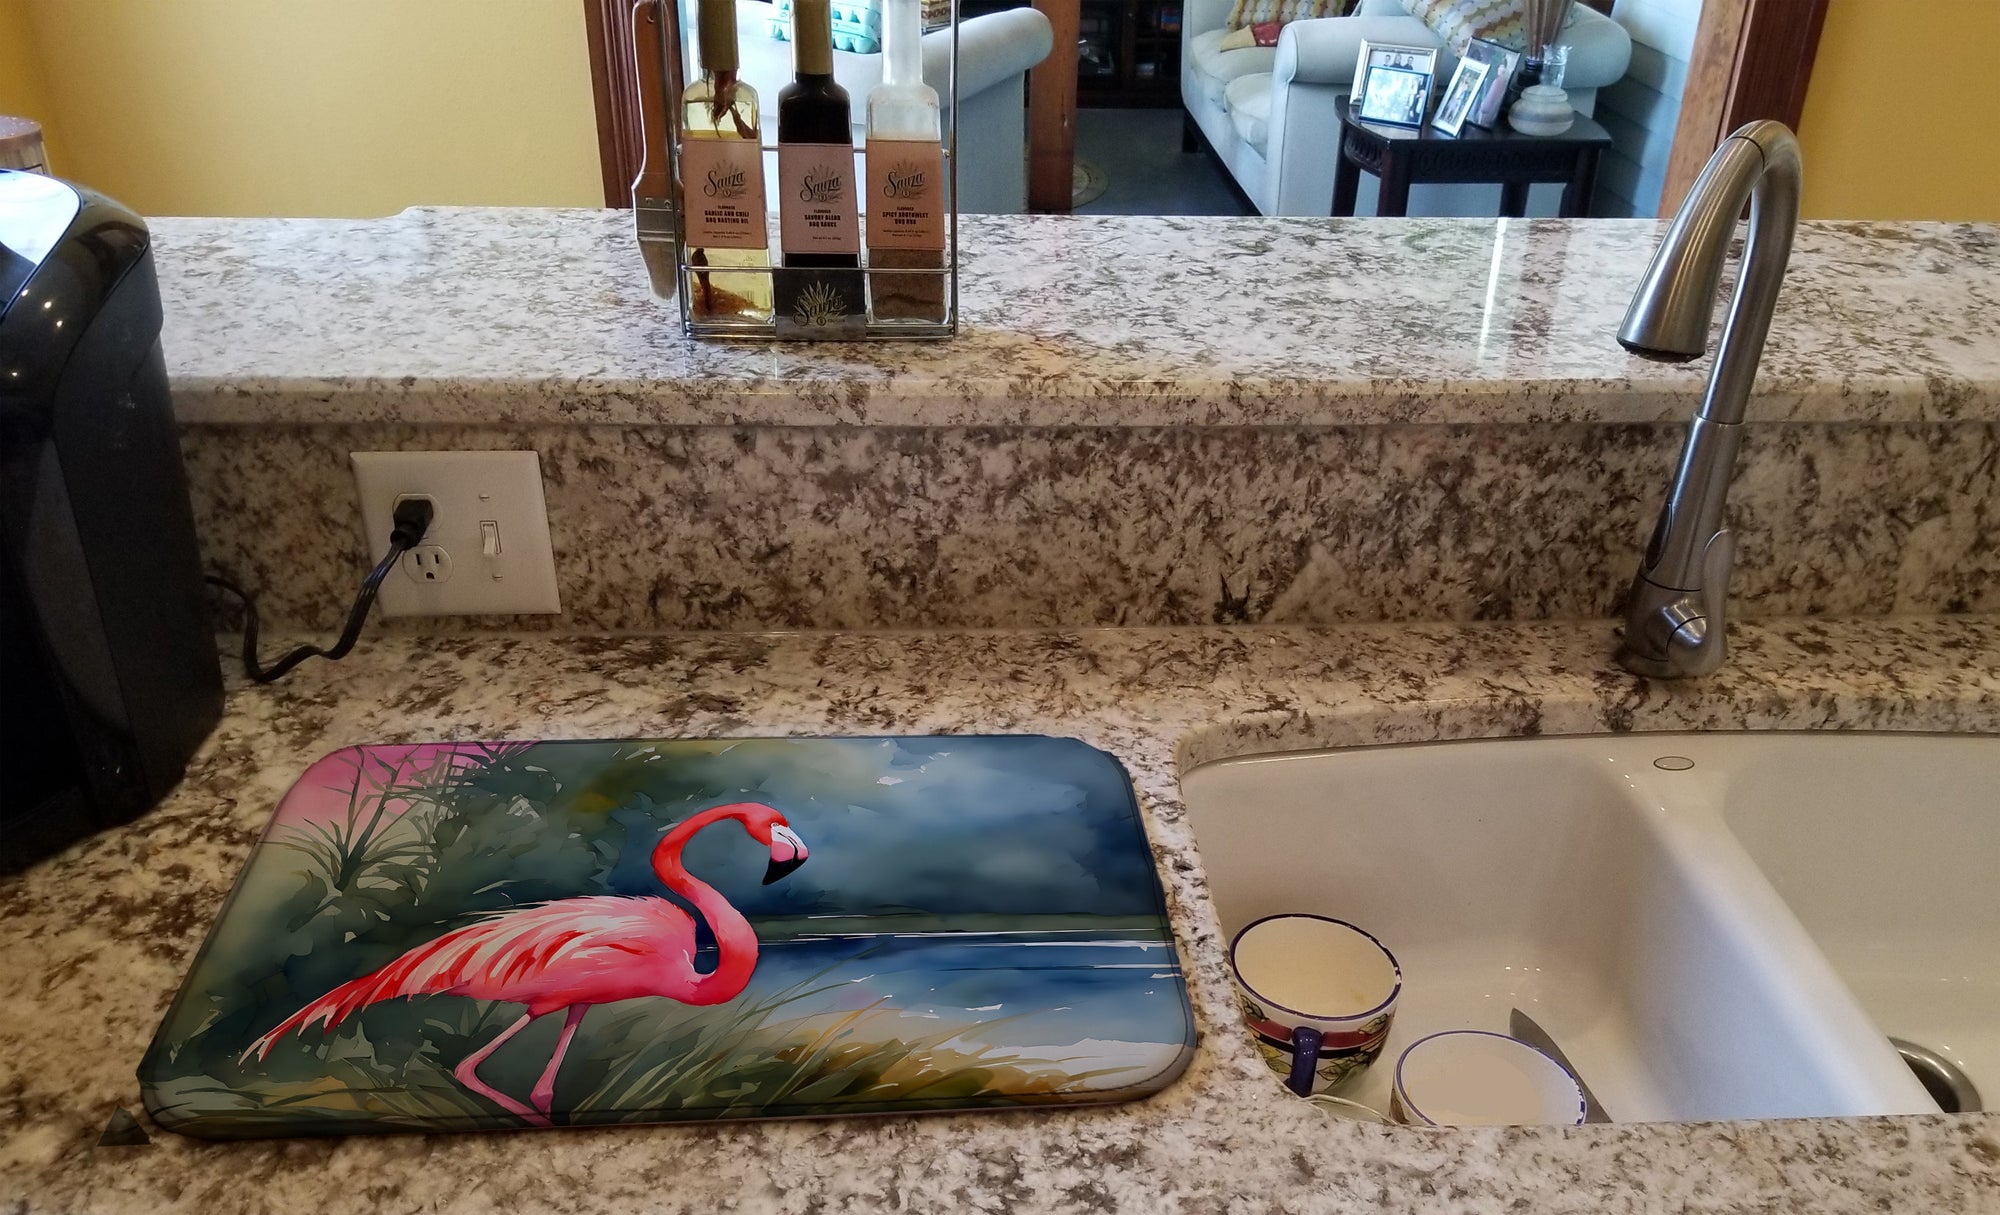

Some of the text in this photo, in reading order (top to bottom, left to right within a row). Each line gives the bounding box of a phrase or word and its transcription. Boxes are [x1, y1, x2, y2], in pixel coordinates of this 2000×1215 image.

[703, 169, 745, 197] Sauza
[800, 175, 842, 202] Sauza
[884, 170, 925, 198] Sauza
[898, 211, 929, 219] SOUTHWEST
